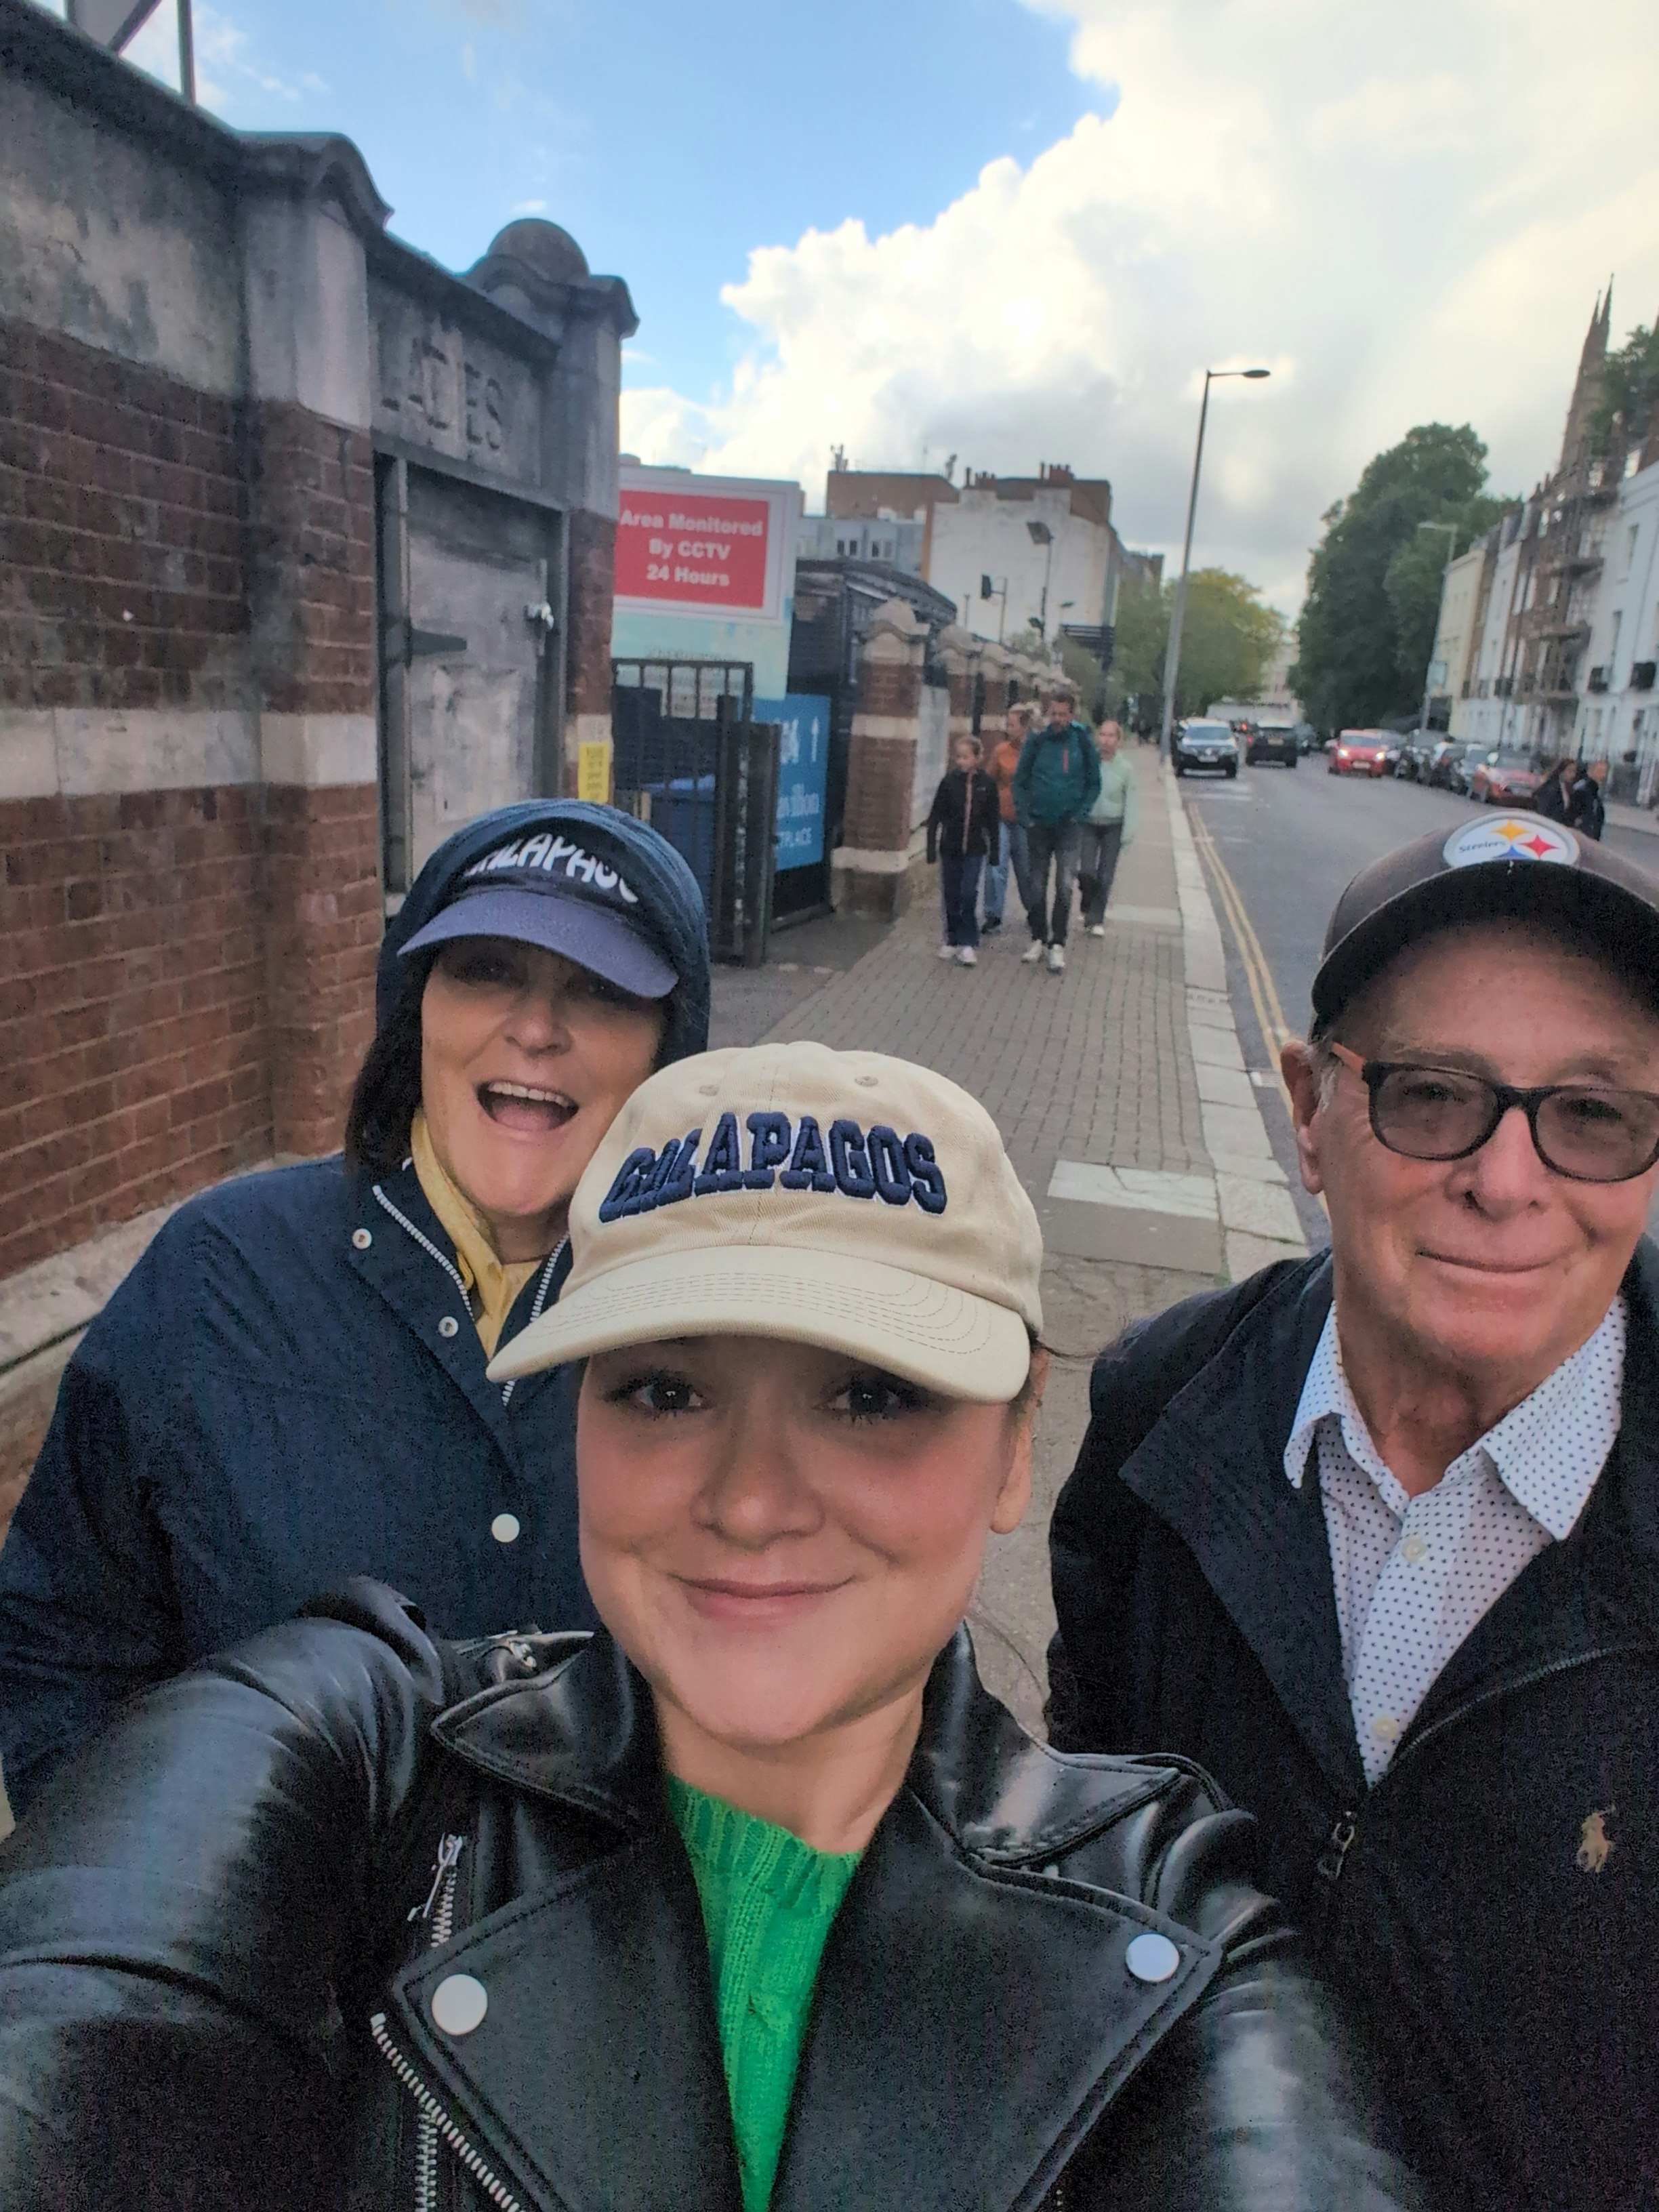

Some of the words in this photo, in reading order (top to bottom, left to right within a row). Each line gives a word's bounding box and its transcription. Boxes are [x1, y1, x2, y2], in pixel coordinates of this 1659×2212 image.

[620, 510, 663, 528] Area
[669, 513, 763, 537] Monitored
[649, 538, 673, 559] By
[678, 541, 731, 560] CCTV
[646, 563, 670, 581] 24
[674, 567, 729, 586] Hours
[1459, 840, 1507, 853] Steelers
[598, 1111, 947, 1223] GALAPAGOS
